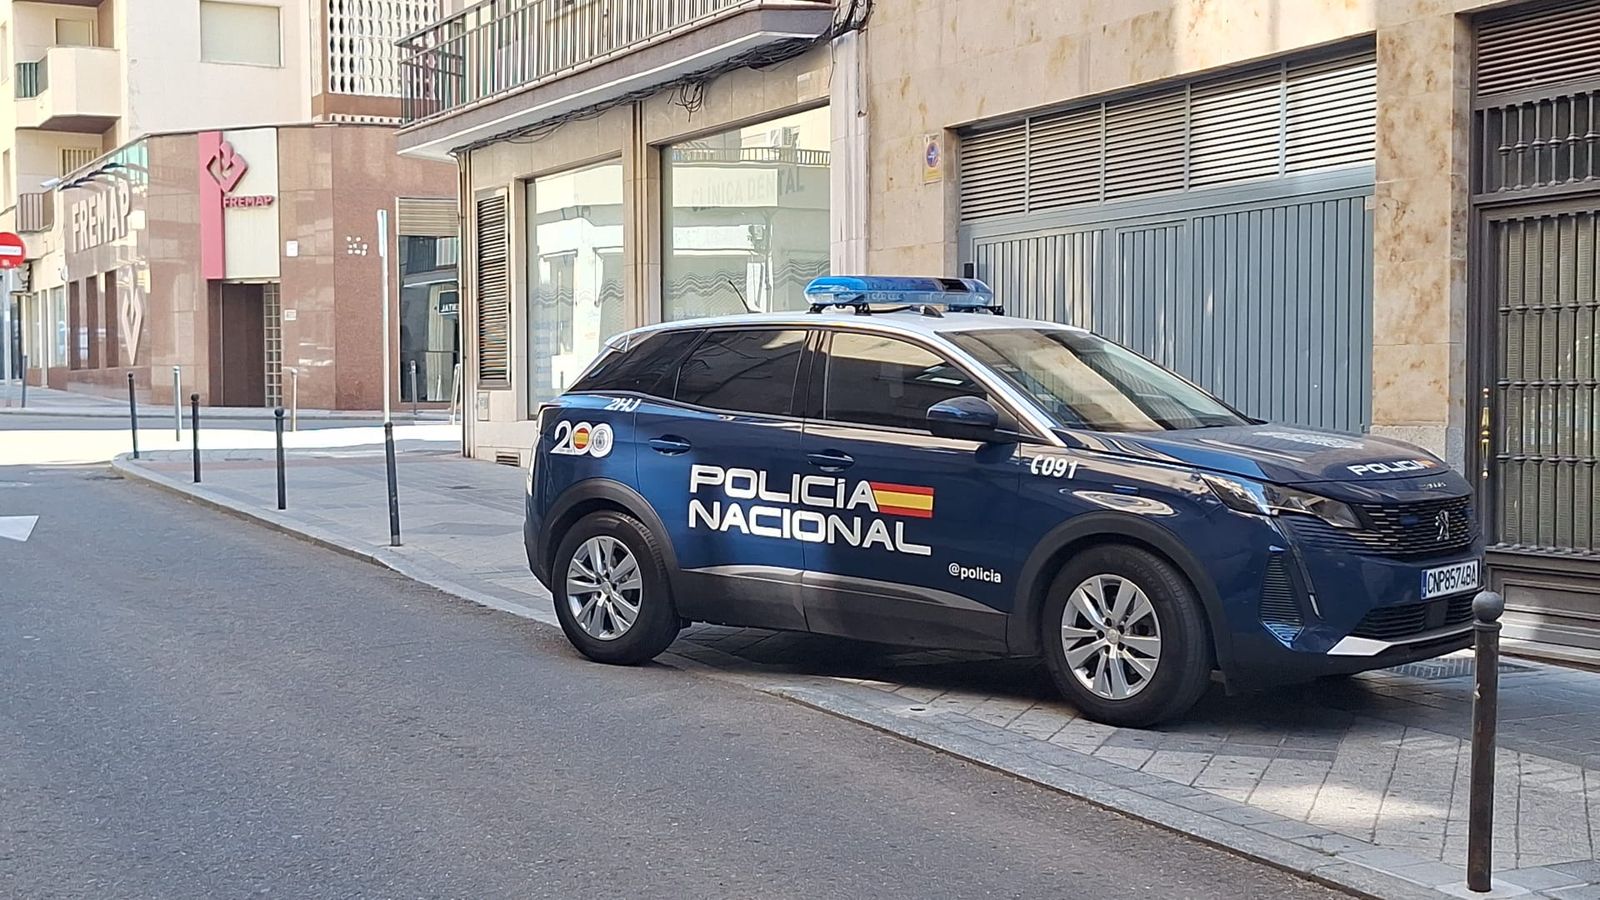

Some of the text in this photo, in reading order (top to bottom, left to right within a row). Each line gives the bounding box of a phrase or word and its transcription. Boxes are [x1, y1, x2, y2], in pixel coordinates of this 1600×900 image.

[72, 178, 130, 254] FREMAP
[224, 195, 274, 208] FREMAP
[604, 398, 641, 412] 2HJ
[550, 420, 613, 458] 200
[688, 499, 932, 556] NACIONAL
[949, 562, 1002, 583] @policia
